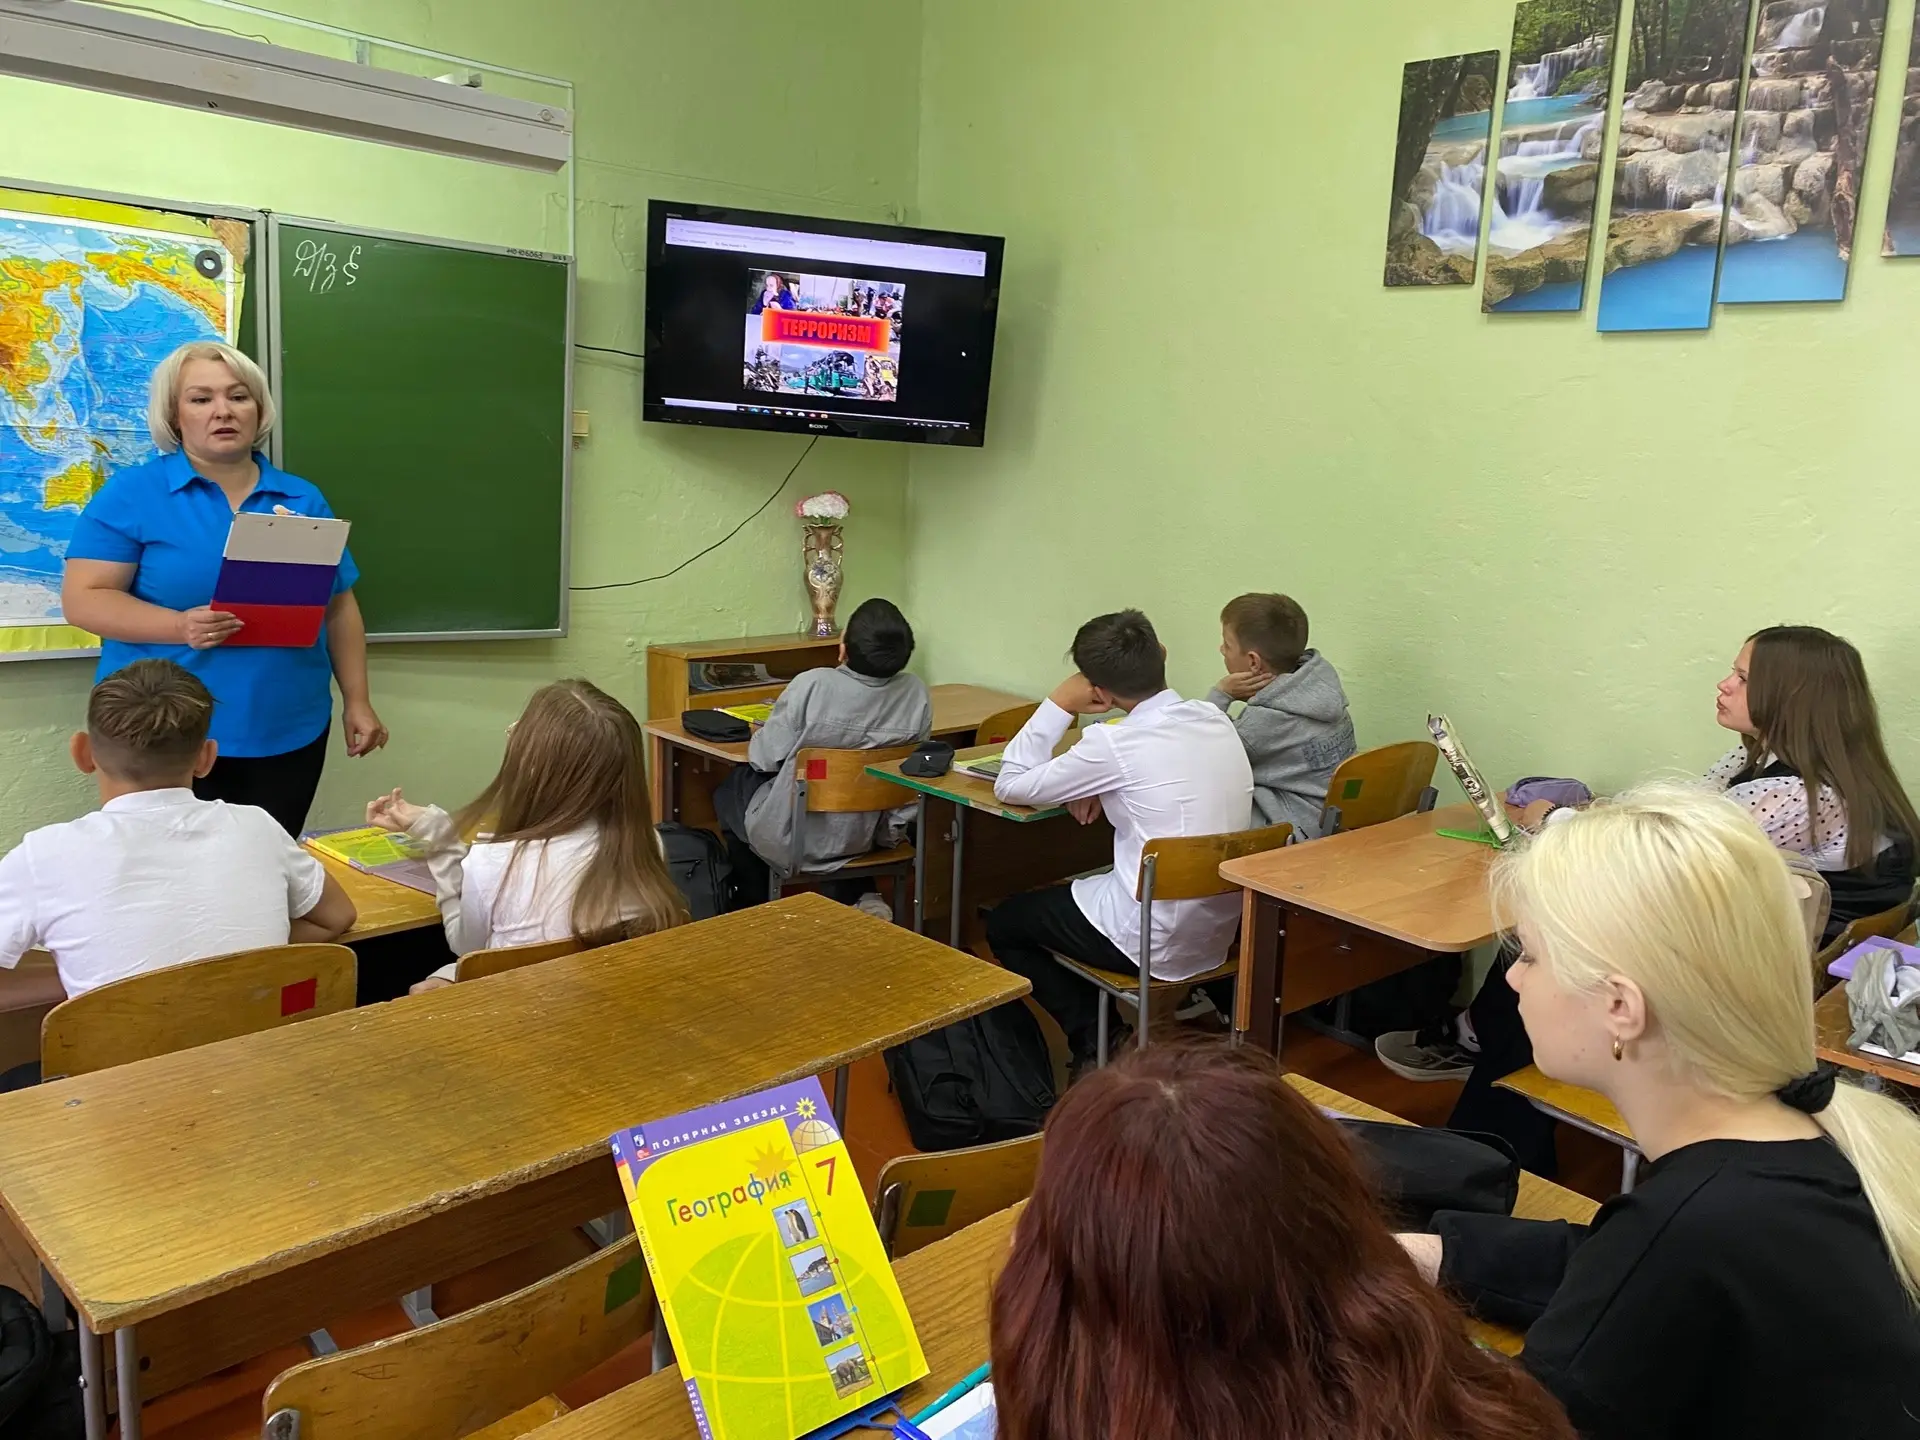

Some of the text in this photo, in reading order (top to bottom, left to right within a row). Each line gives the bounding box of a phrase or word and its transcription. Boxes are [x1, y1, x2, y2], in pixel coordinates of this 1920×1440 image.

[781, 318, 872, 343] ТЕРРОРИЗМ
[652, 1103, 787, 1151] ПОЛЯРНАЯ ЗВЕЗДА
[666, 1170, 792, 1226] География
[815, 1156, 837, 1197] 7
[638, 1225, 657, 1275] География
